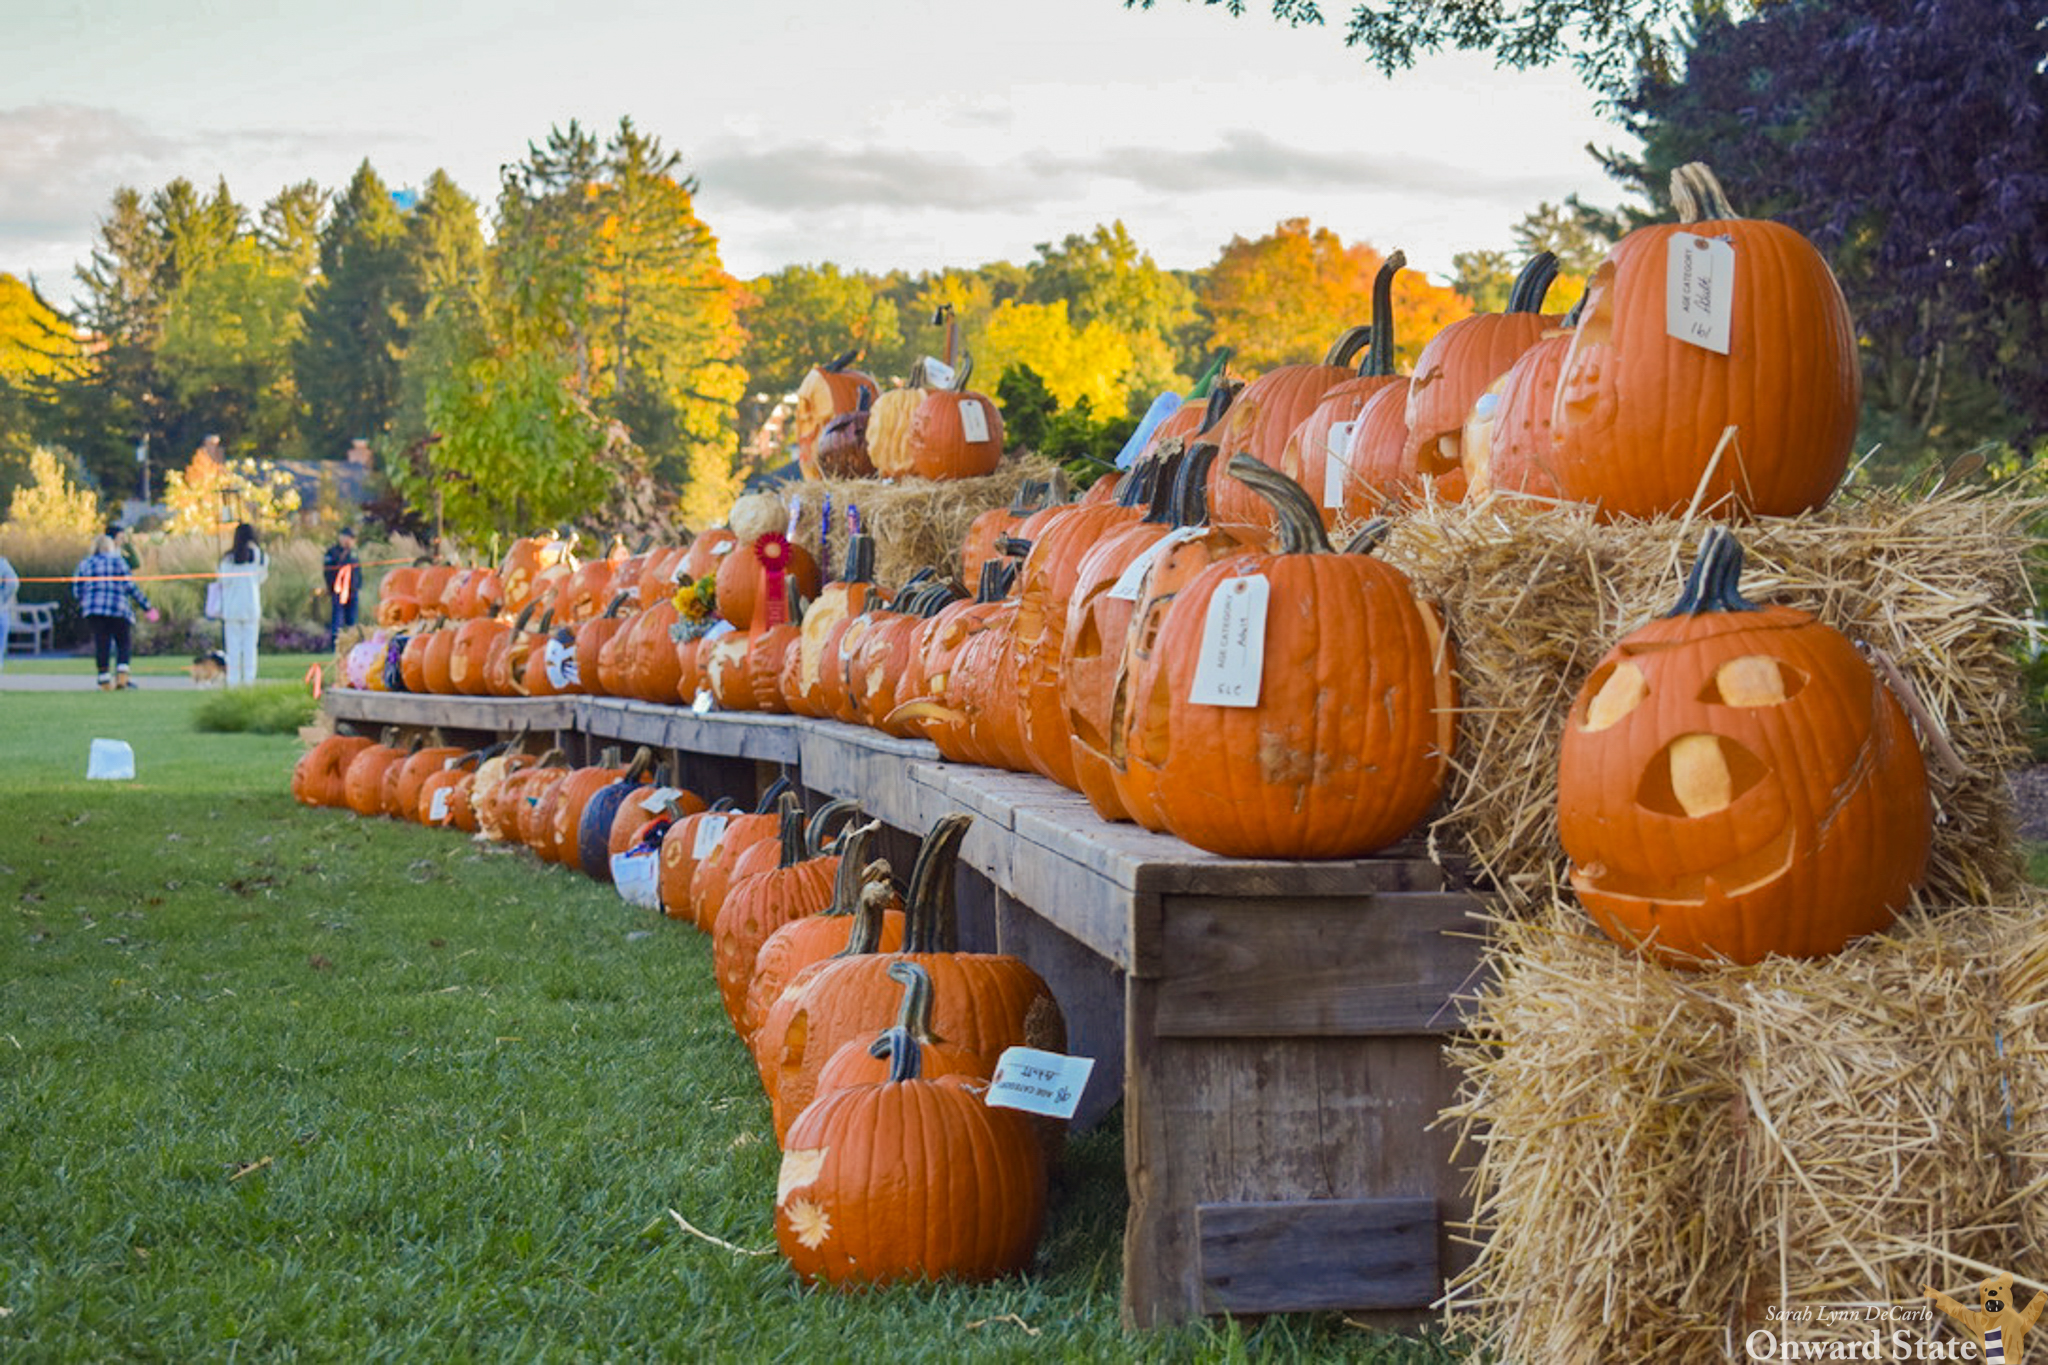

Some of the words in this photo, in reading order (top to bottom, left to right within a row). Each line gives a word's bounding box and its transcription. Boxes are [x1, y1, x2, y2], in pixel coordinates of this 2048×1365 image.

[1683, 248, 1692, 294] CATEGORY
[1682, 296, 1691, 313] AGE
[1220, 594, 1232, 647] CATEGORY
[1217, 649, 1227, 669] AGE
